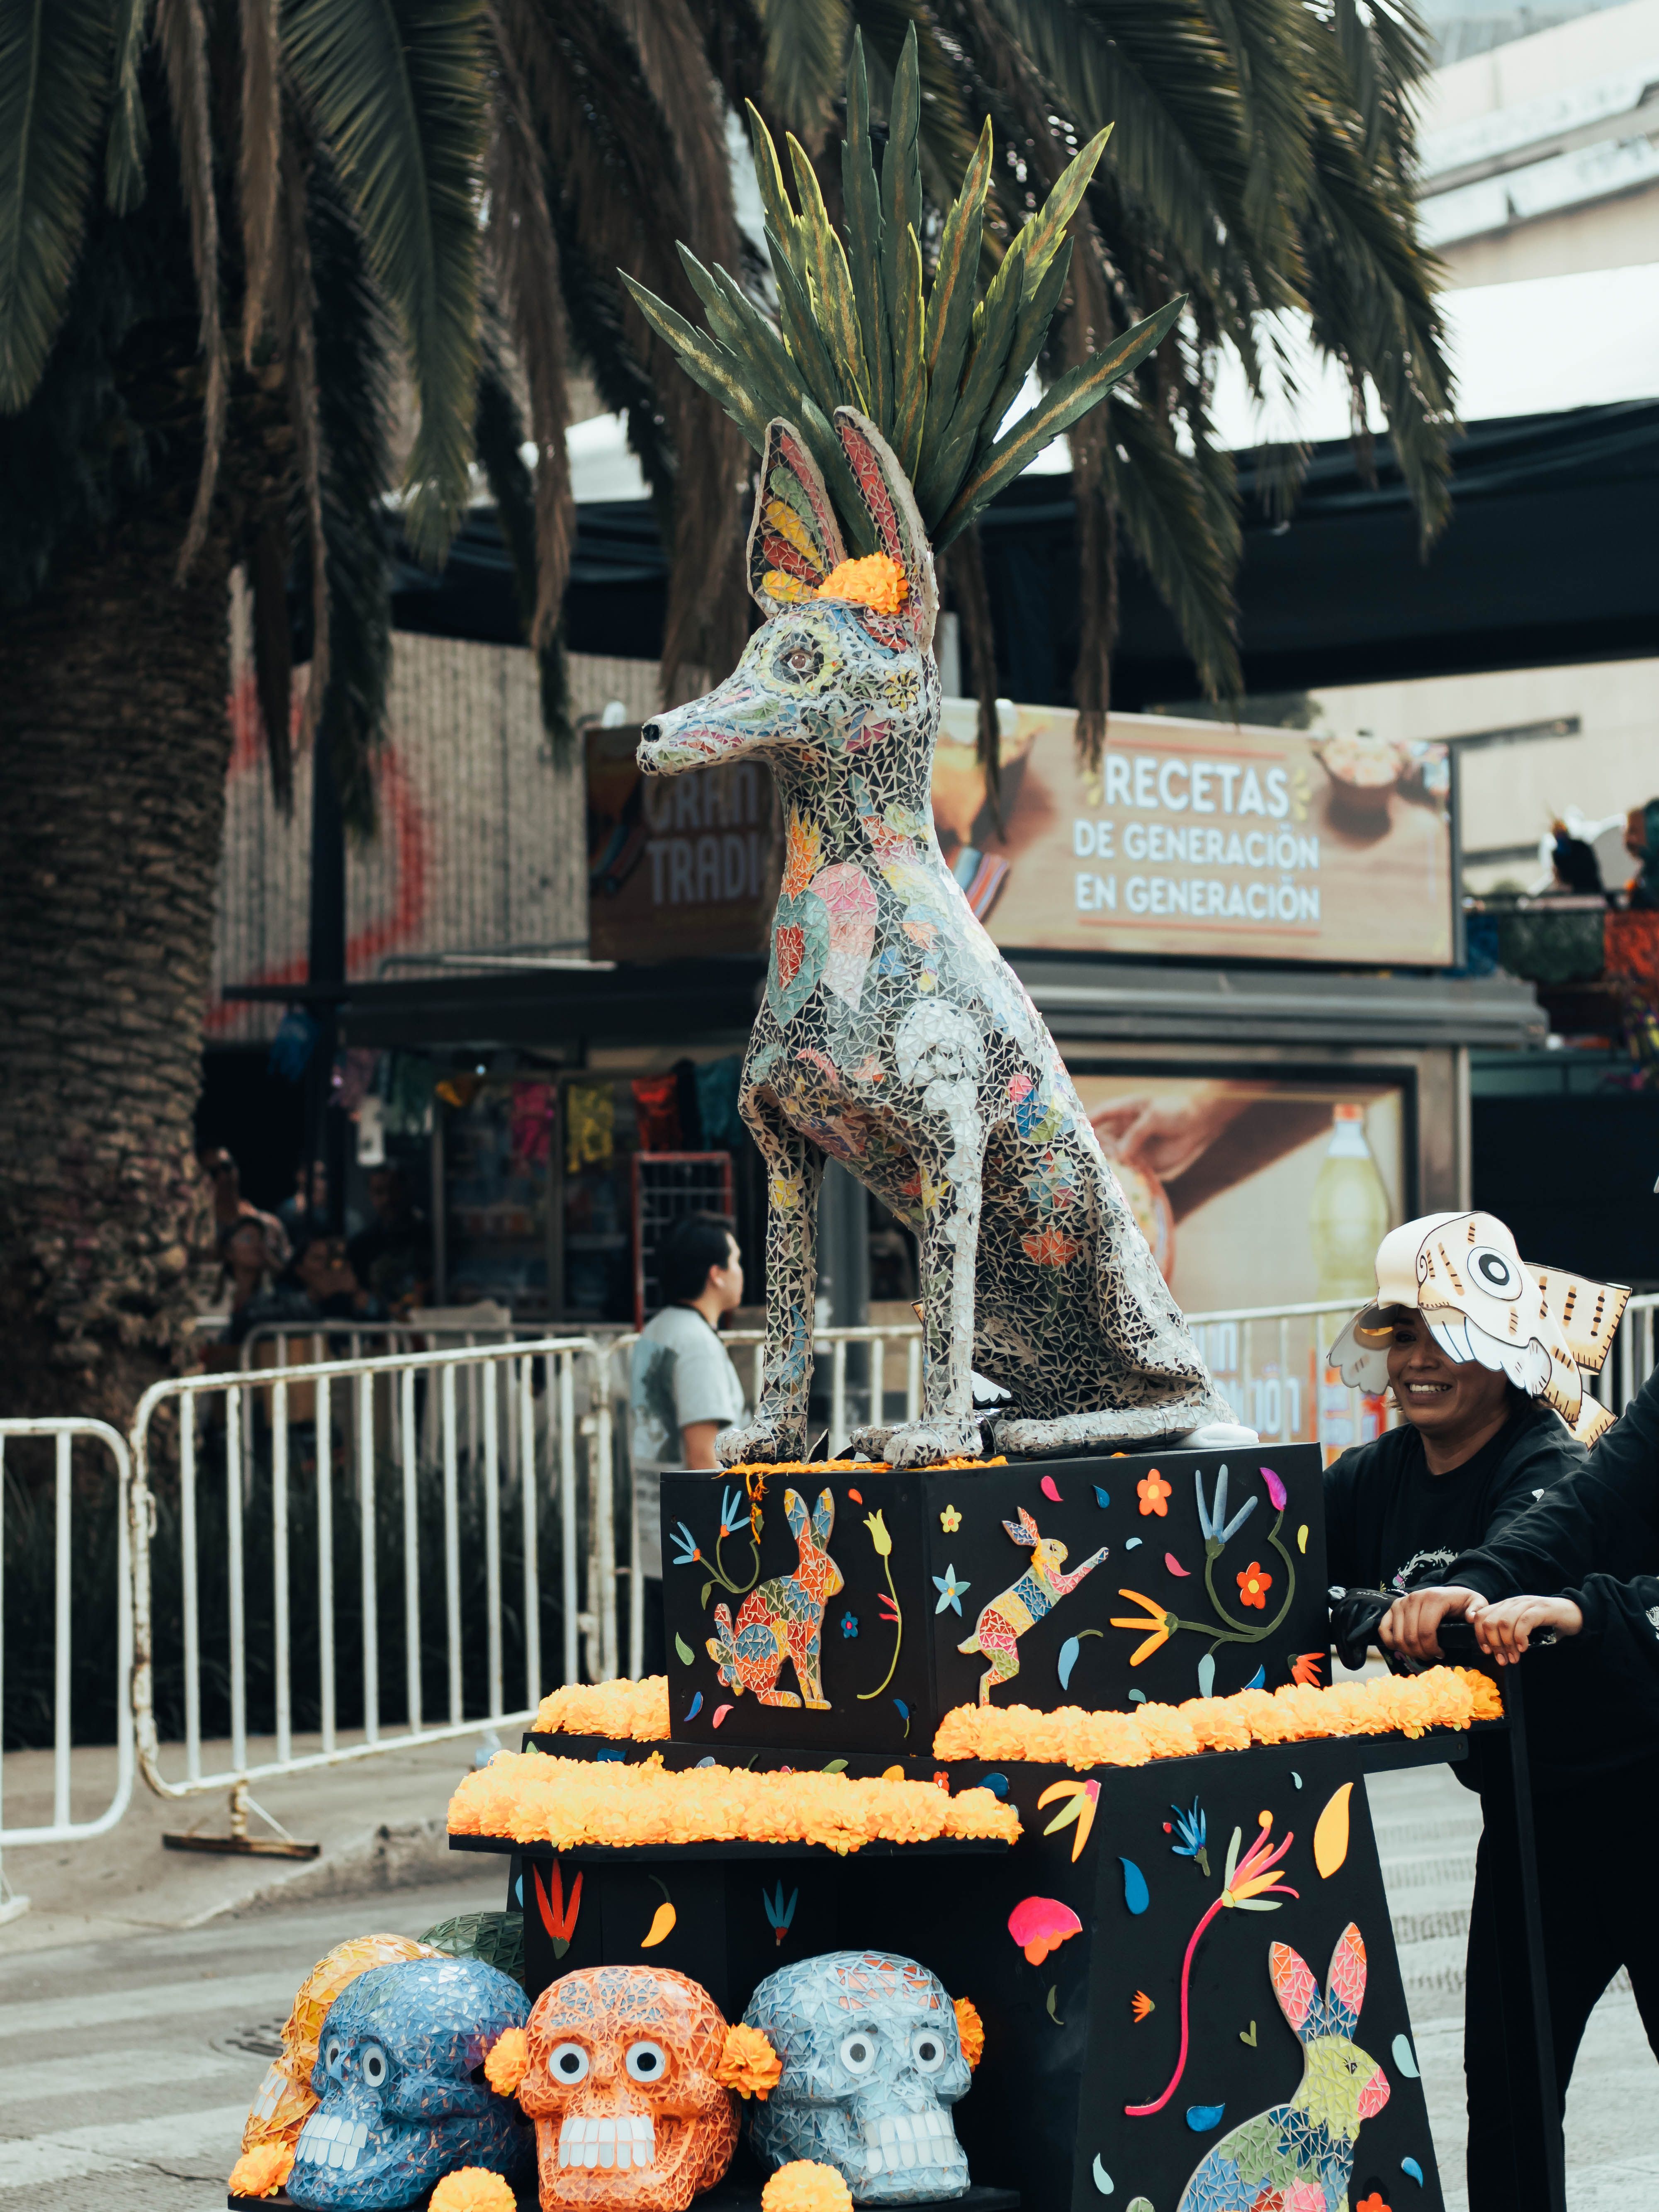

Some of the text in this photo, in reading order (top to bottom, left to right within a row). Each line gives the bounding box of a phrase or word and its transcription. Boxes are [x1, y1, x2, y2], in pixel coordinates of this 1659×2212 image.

[1105, 754, 1289, 818] RECETAS
[647, 833, 765, 905] TRADI
[1074, 819, 1319, 869] DE GENERACIÓN
[1076, 873, 1320, 921] EN GENERACIÓN
